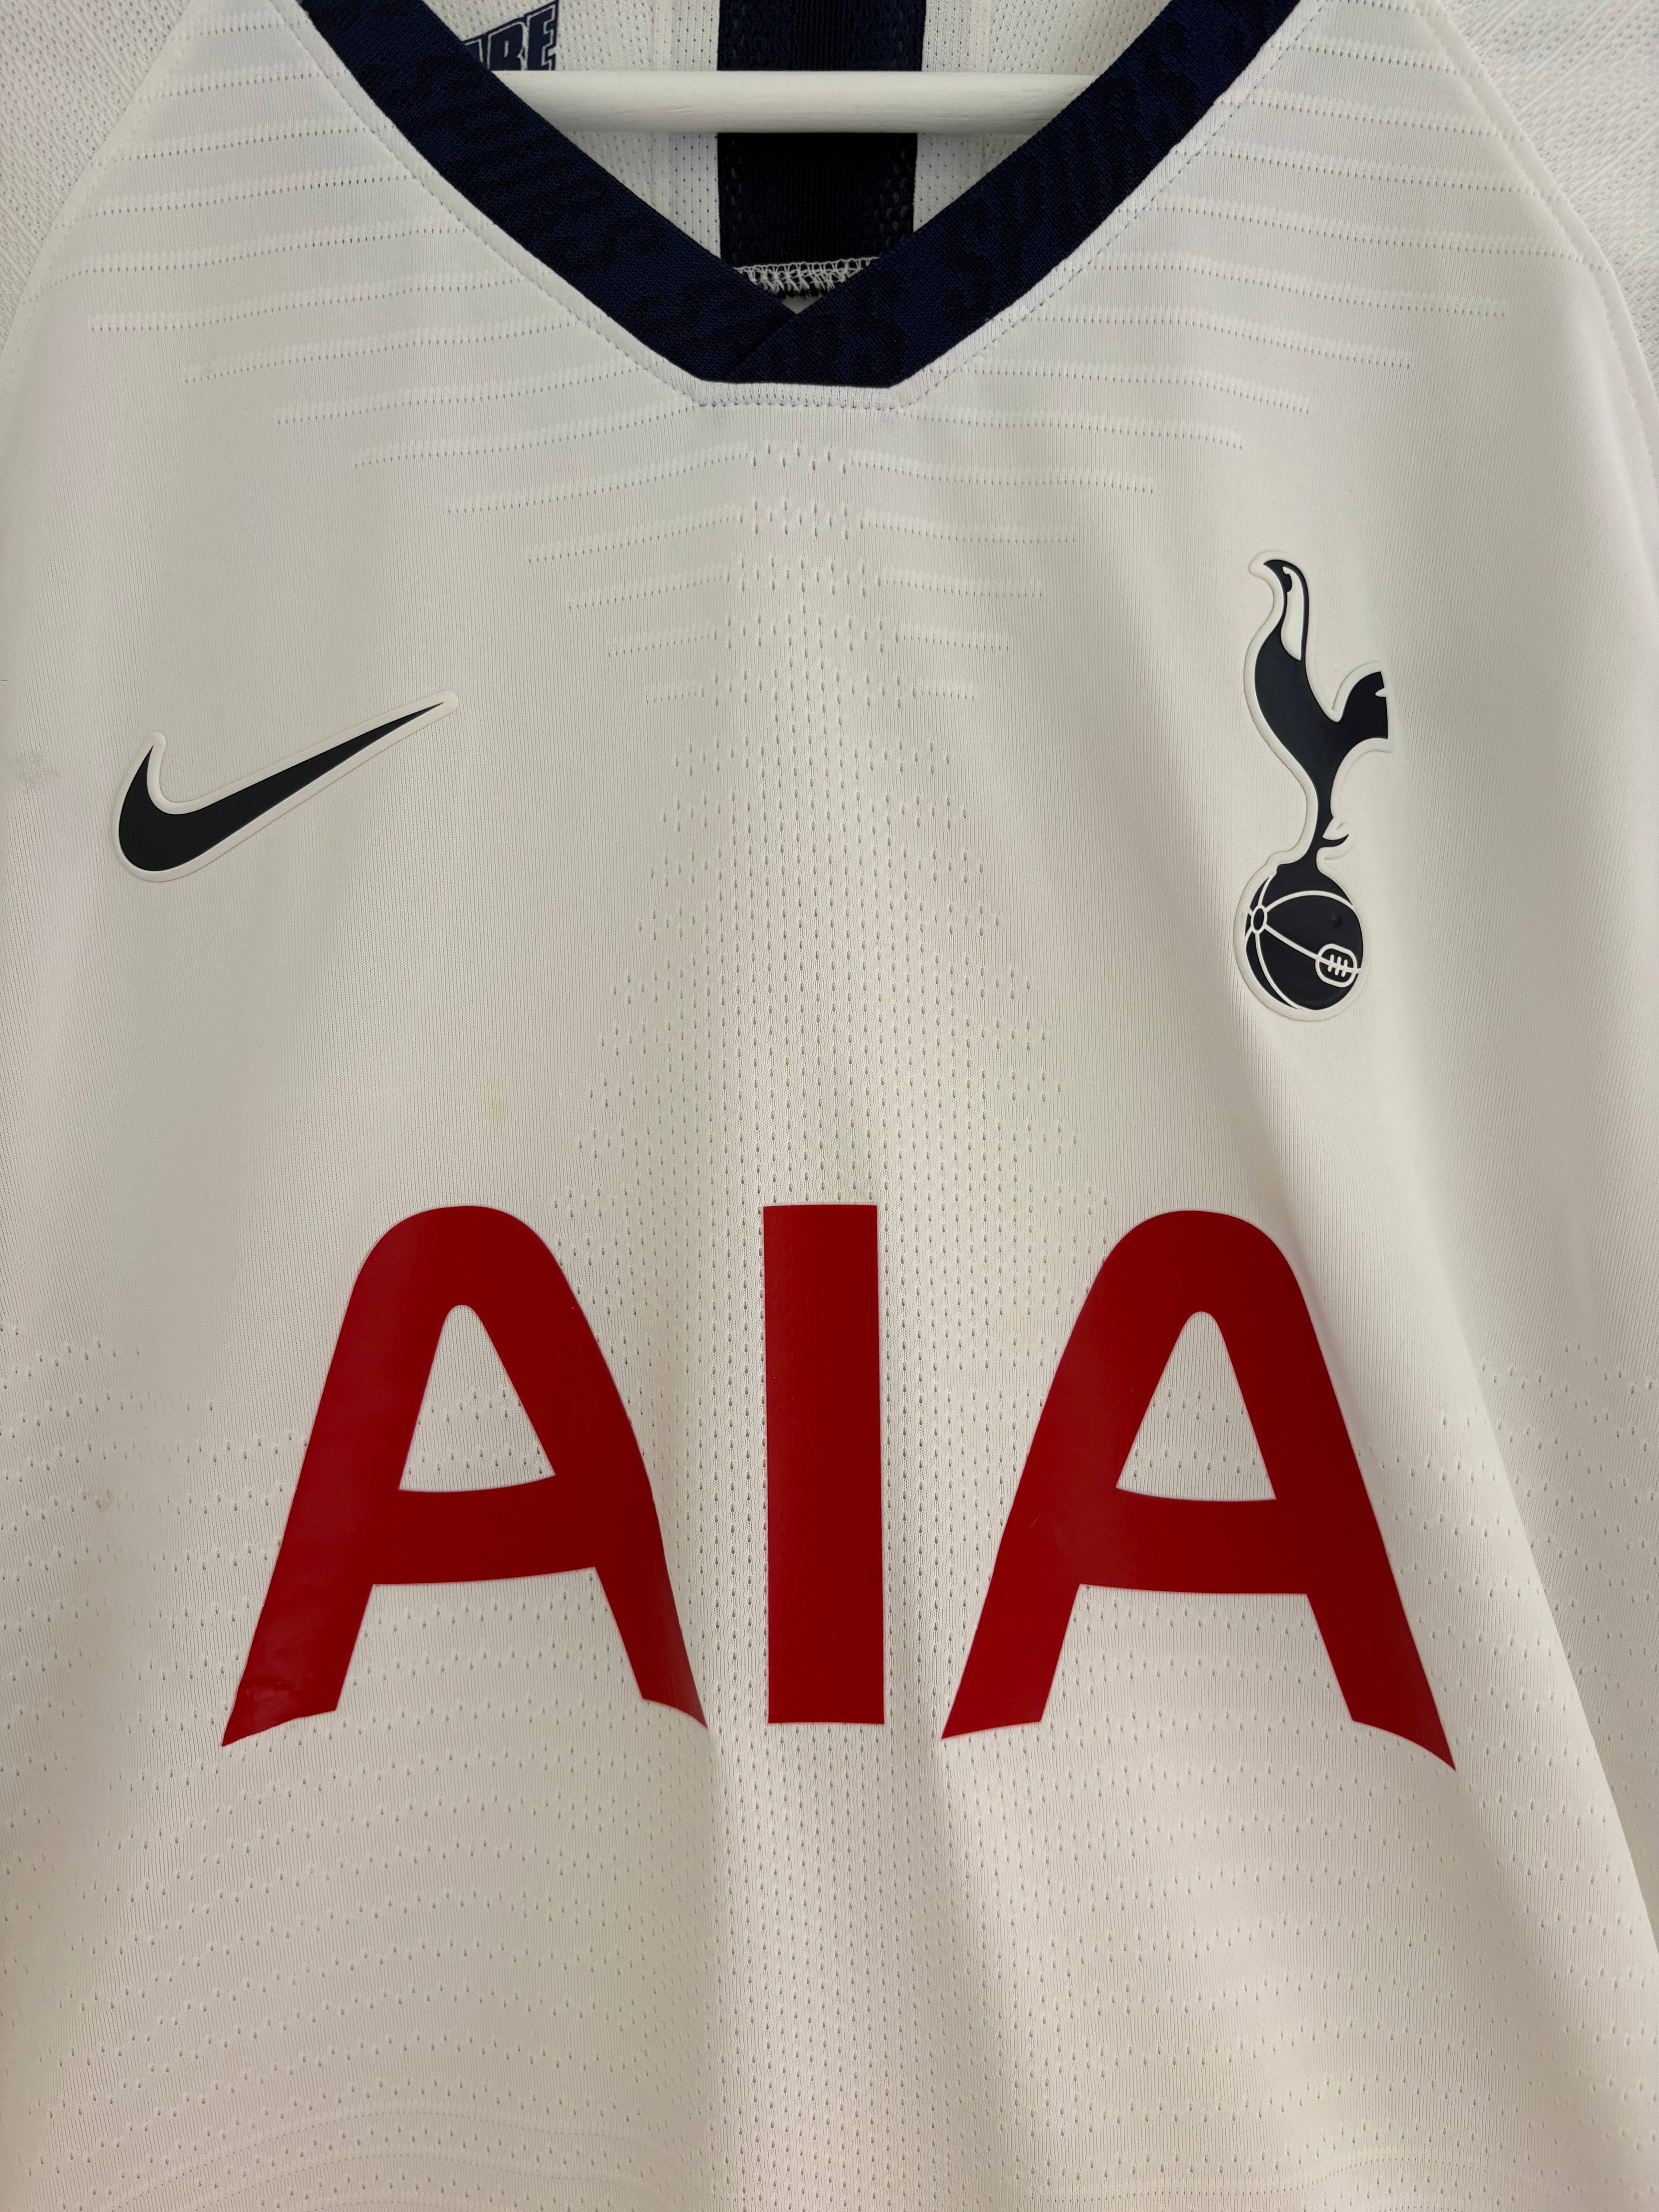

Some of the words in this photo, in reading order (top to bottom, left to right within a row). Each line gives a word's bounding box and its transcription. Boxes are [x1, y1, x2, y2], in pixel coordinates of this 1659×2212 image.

[461, 1, 558, 70] RE
[944, 19, 1200, 321] SPURS
[222, 1204, 1456, 1770] AIA
